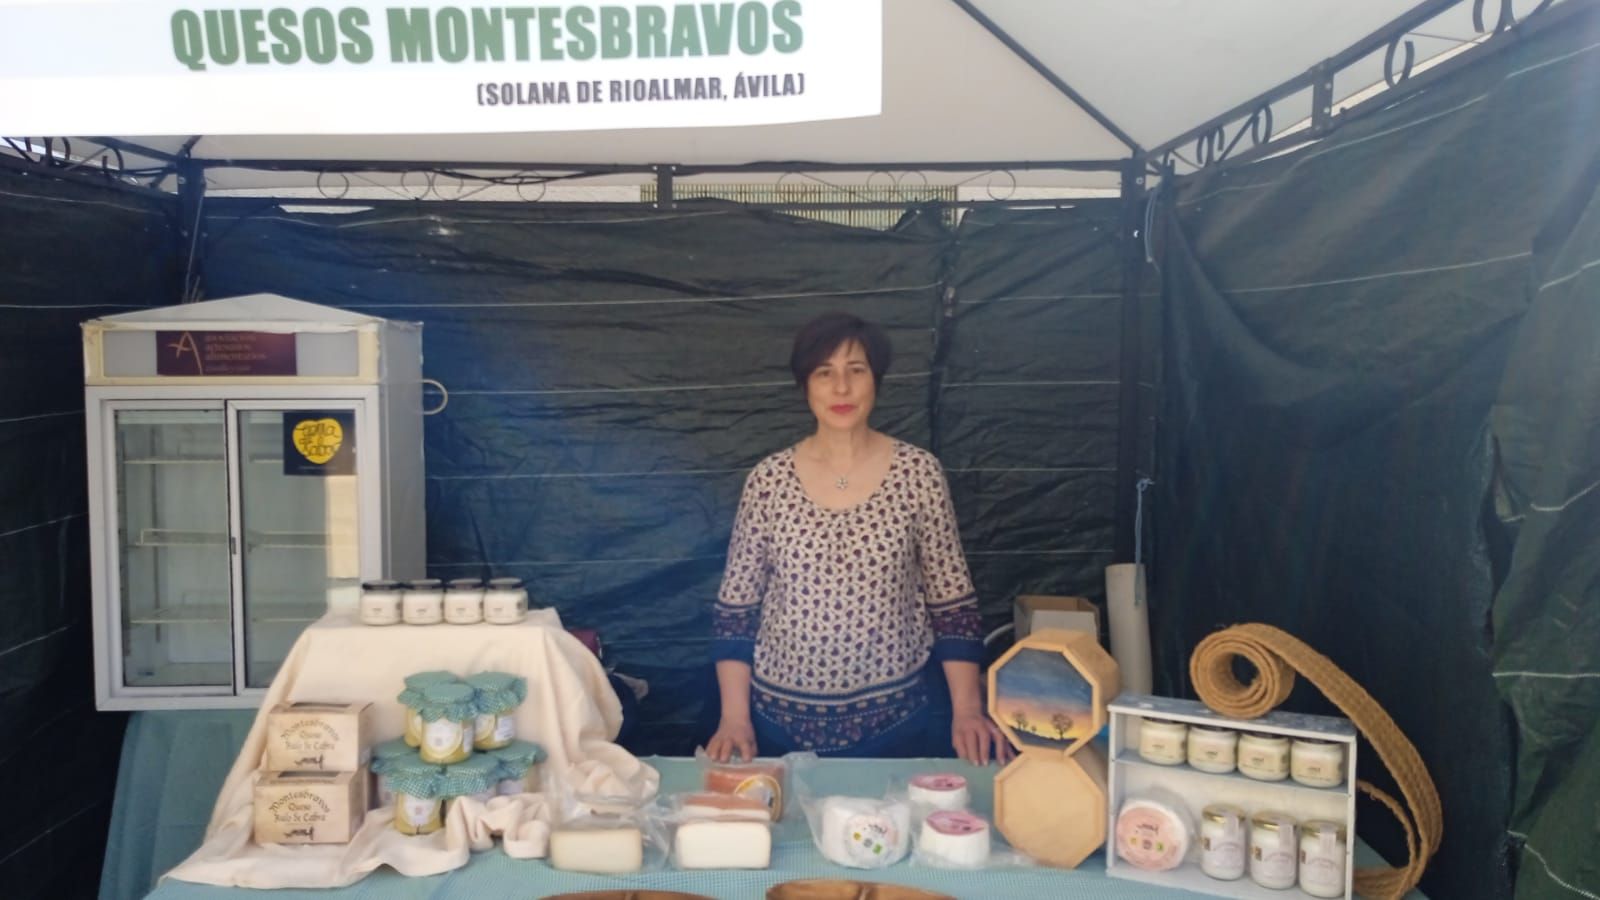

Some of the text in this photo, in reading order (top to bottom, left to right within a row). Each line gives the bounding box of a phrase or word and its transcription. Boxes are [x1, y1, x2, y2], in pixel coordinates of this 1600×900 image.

[171, 0, 805, 70] QUESOS MONTESBRAVOS
[477, 72, 805, 106] (SOLANA DE RIOALMAR, ÁVILA)
